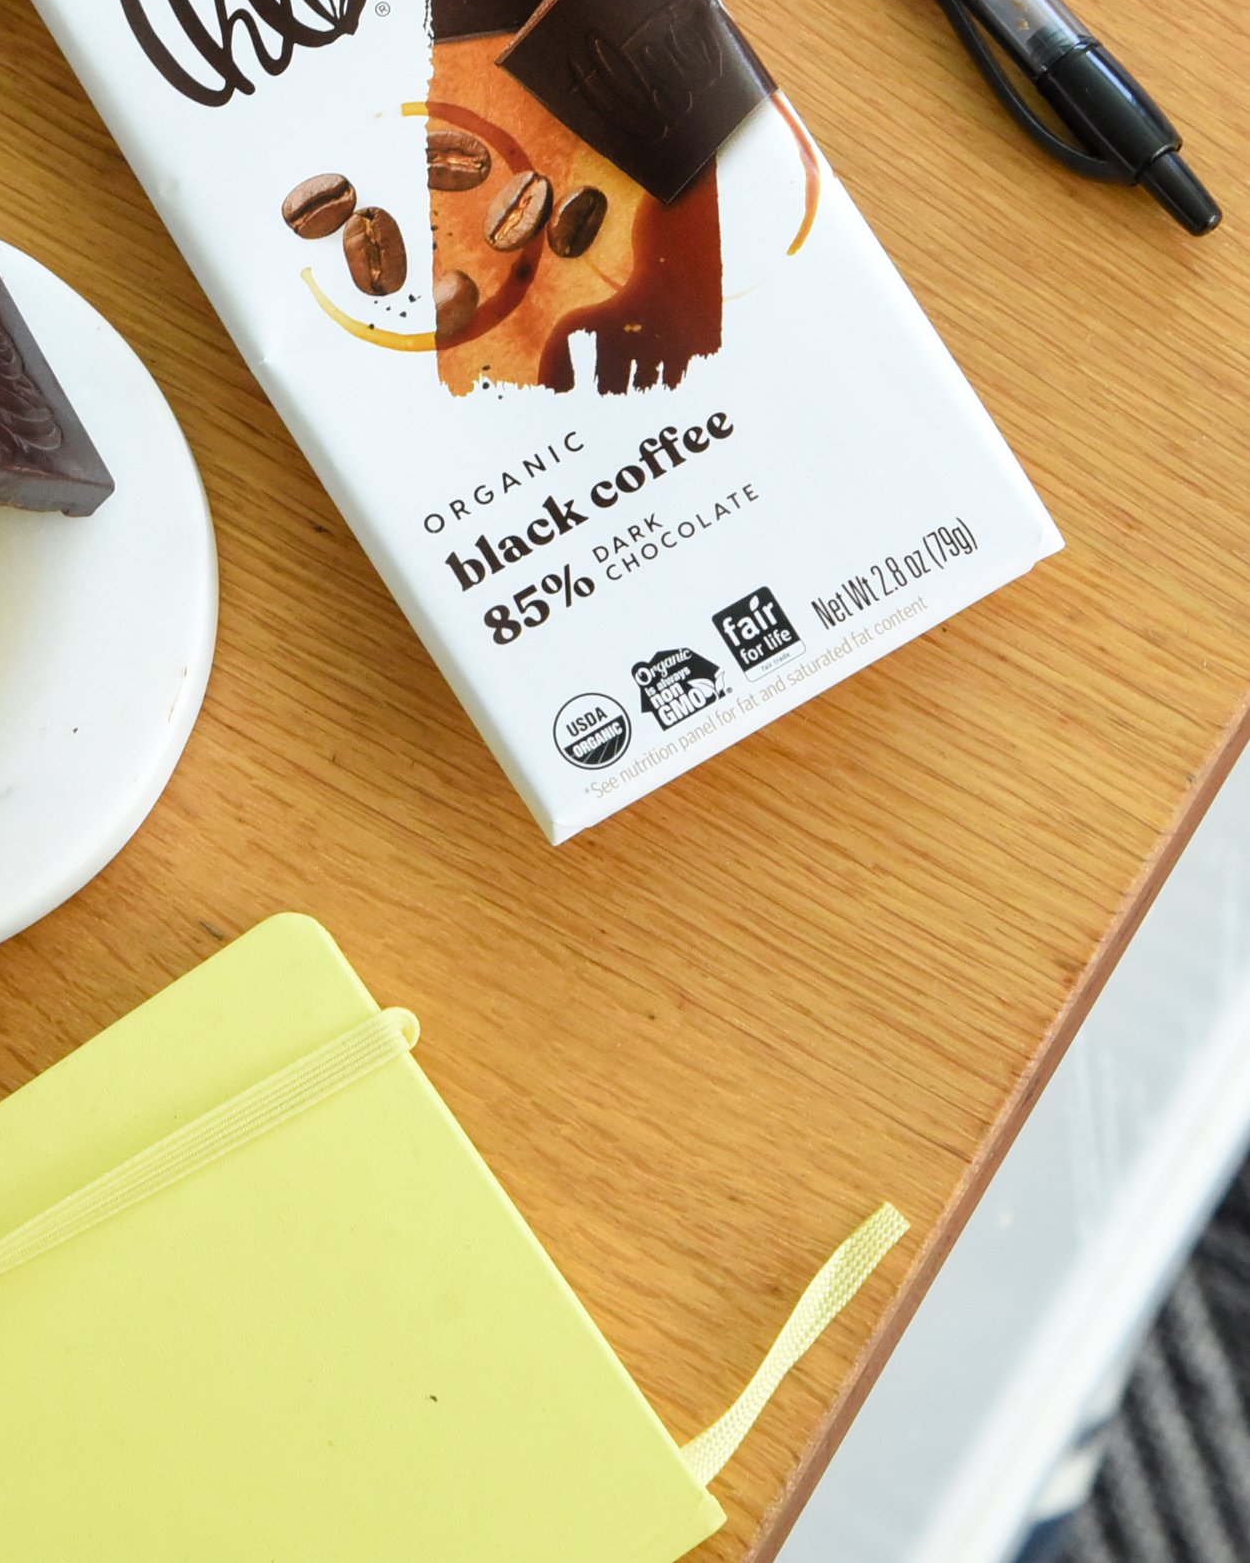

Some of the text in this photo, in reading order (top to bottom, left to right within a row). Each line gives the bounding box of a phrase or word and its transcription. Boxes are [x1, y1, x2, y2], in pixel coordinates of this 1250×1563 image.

[423, 431, 585, 534] ORGANIC
[444, 411, 734, 592] black coffee
[591, 512, 664, 563] DARK
[605, 483, 760, 580] CHOCOLATE
[810, 517, 978, 630] Net Wt 2.8 oz (79g)
[483, 563, 595, 645] 85%
[722, 596, 778, 647] fair
[635, 648, 693, 686] Organic
[739, 627, 792, 666] for life
[619, 741, 679, 784] nutrition
[678, 719, 718, 750] panel
[715, 708, 739, 727] for
[735, 695, 760, 716] fat
[761, 675, 788, 701] and
[786, 636, 854, 686] saturated
[850, 626, 875, 648] fat
[874, 595, 929, 636] content
[650, 682, 684, 709] non
[657, 666, 691, 694] always
[566, 706, 608, 738] USDA
[658, 687, 708, 726] GMO
[571, 721, 624, 759] ORGANIC
